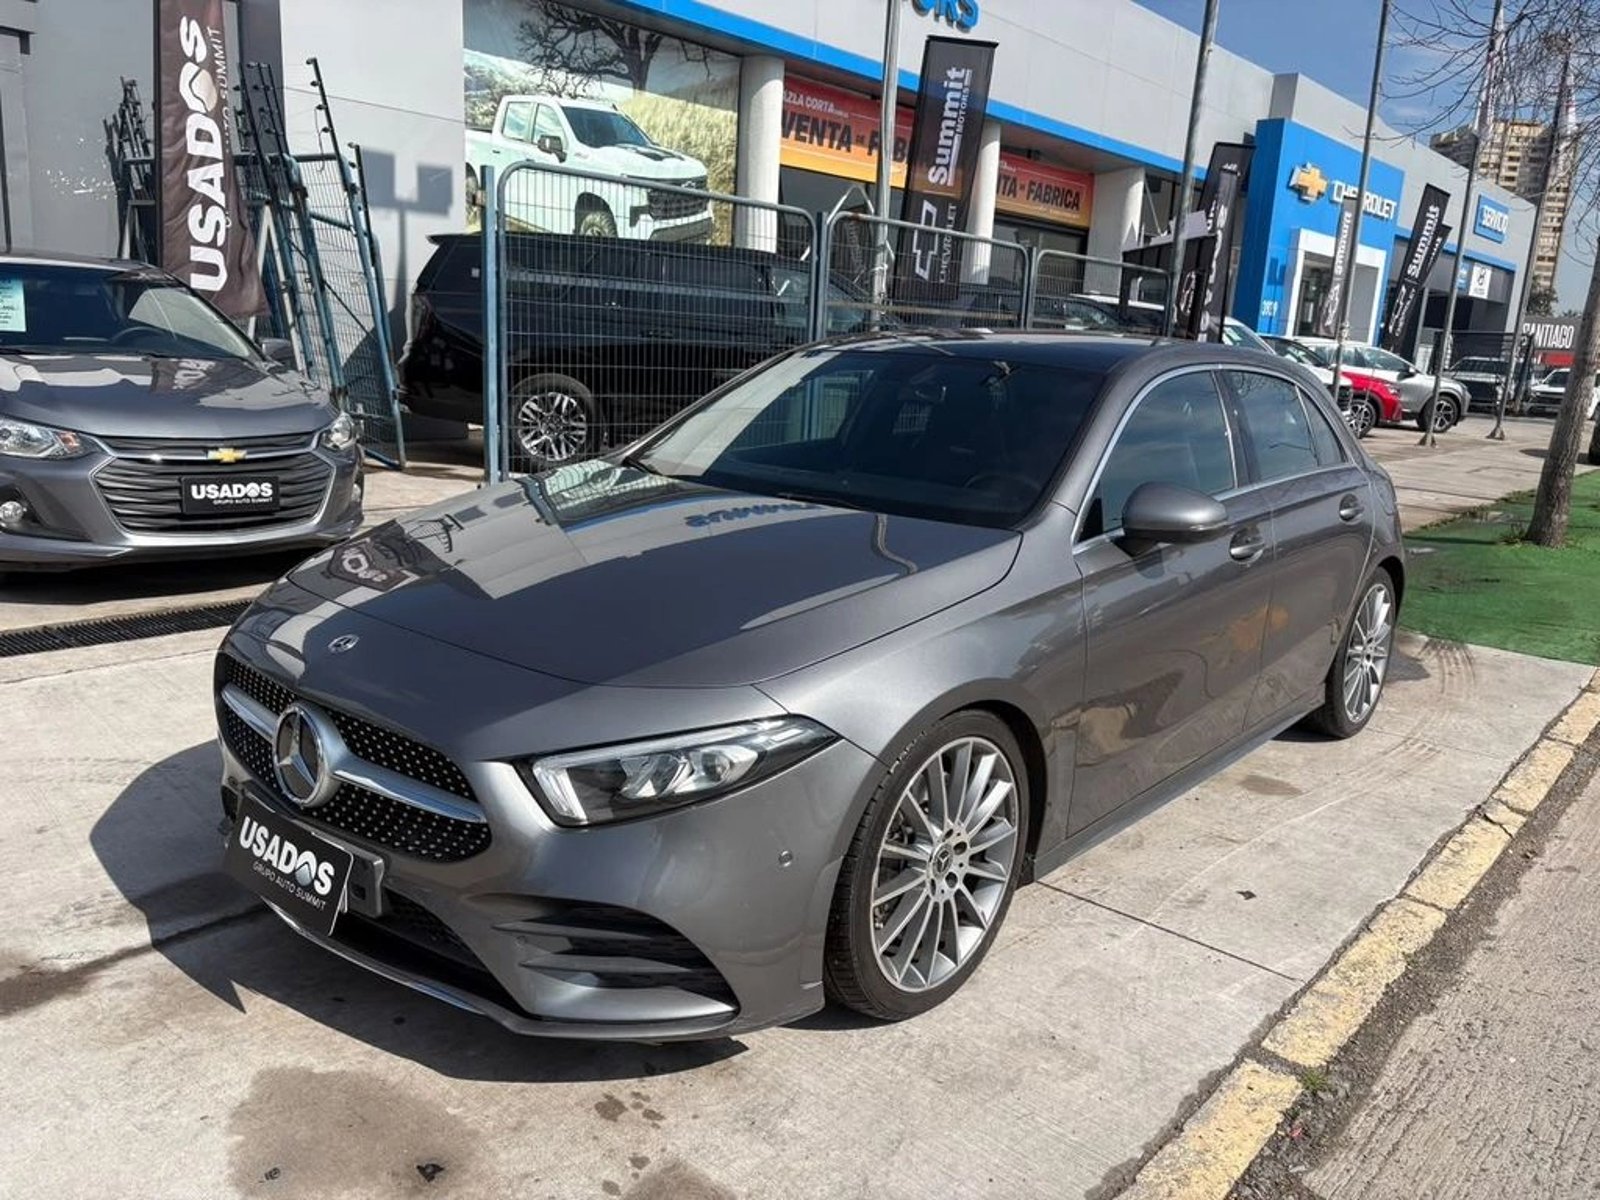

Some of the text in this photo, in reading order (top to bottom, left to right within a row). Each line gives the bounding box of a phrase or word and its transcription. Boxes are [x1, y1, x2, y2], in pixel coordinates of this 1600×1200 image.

[781, 112, 852, 153] VENTA
[928, 67, 966, 186] Summit
[955, 86, 970, 134] MOTORS
[179, 16, 227, 291] USADOS
[1026, 180, 1081, 212] FABRICA
[1407, 204, 1440, 277] Summit
[191, 482, 273, 499] USADOS
[239, 816, 335, 895] USADOS
[253, 861, 327, 911] GRUPO AUTO SUMMIT
